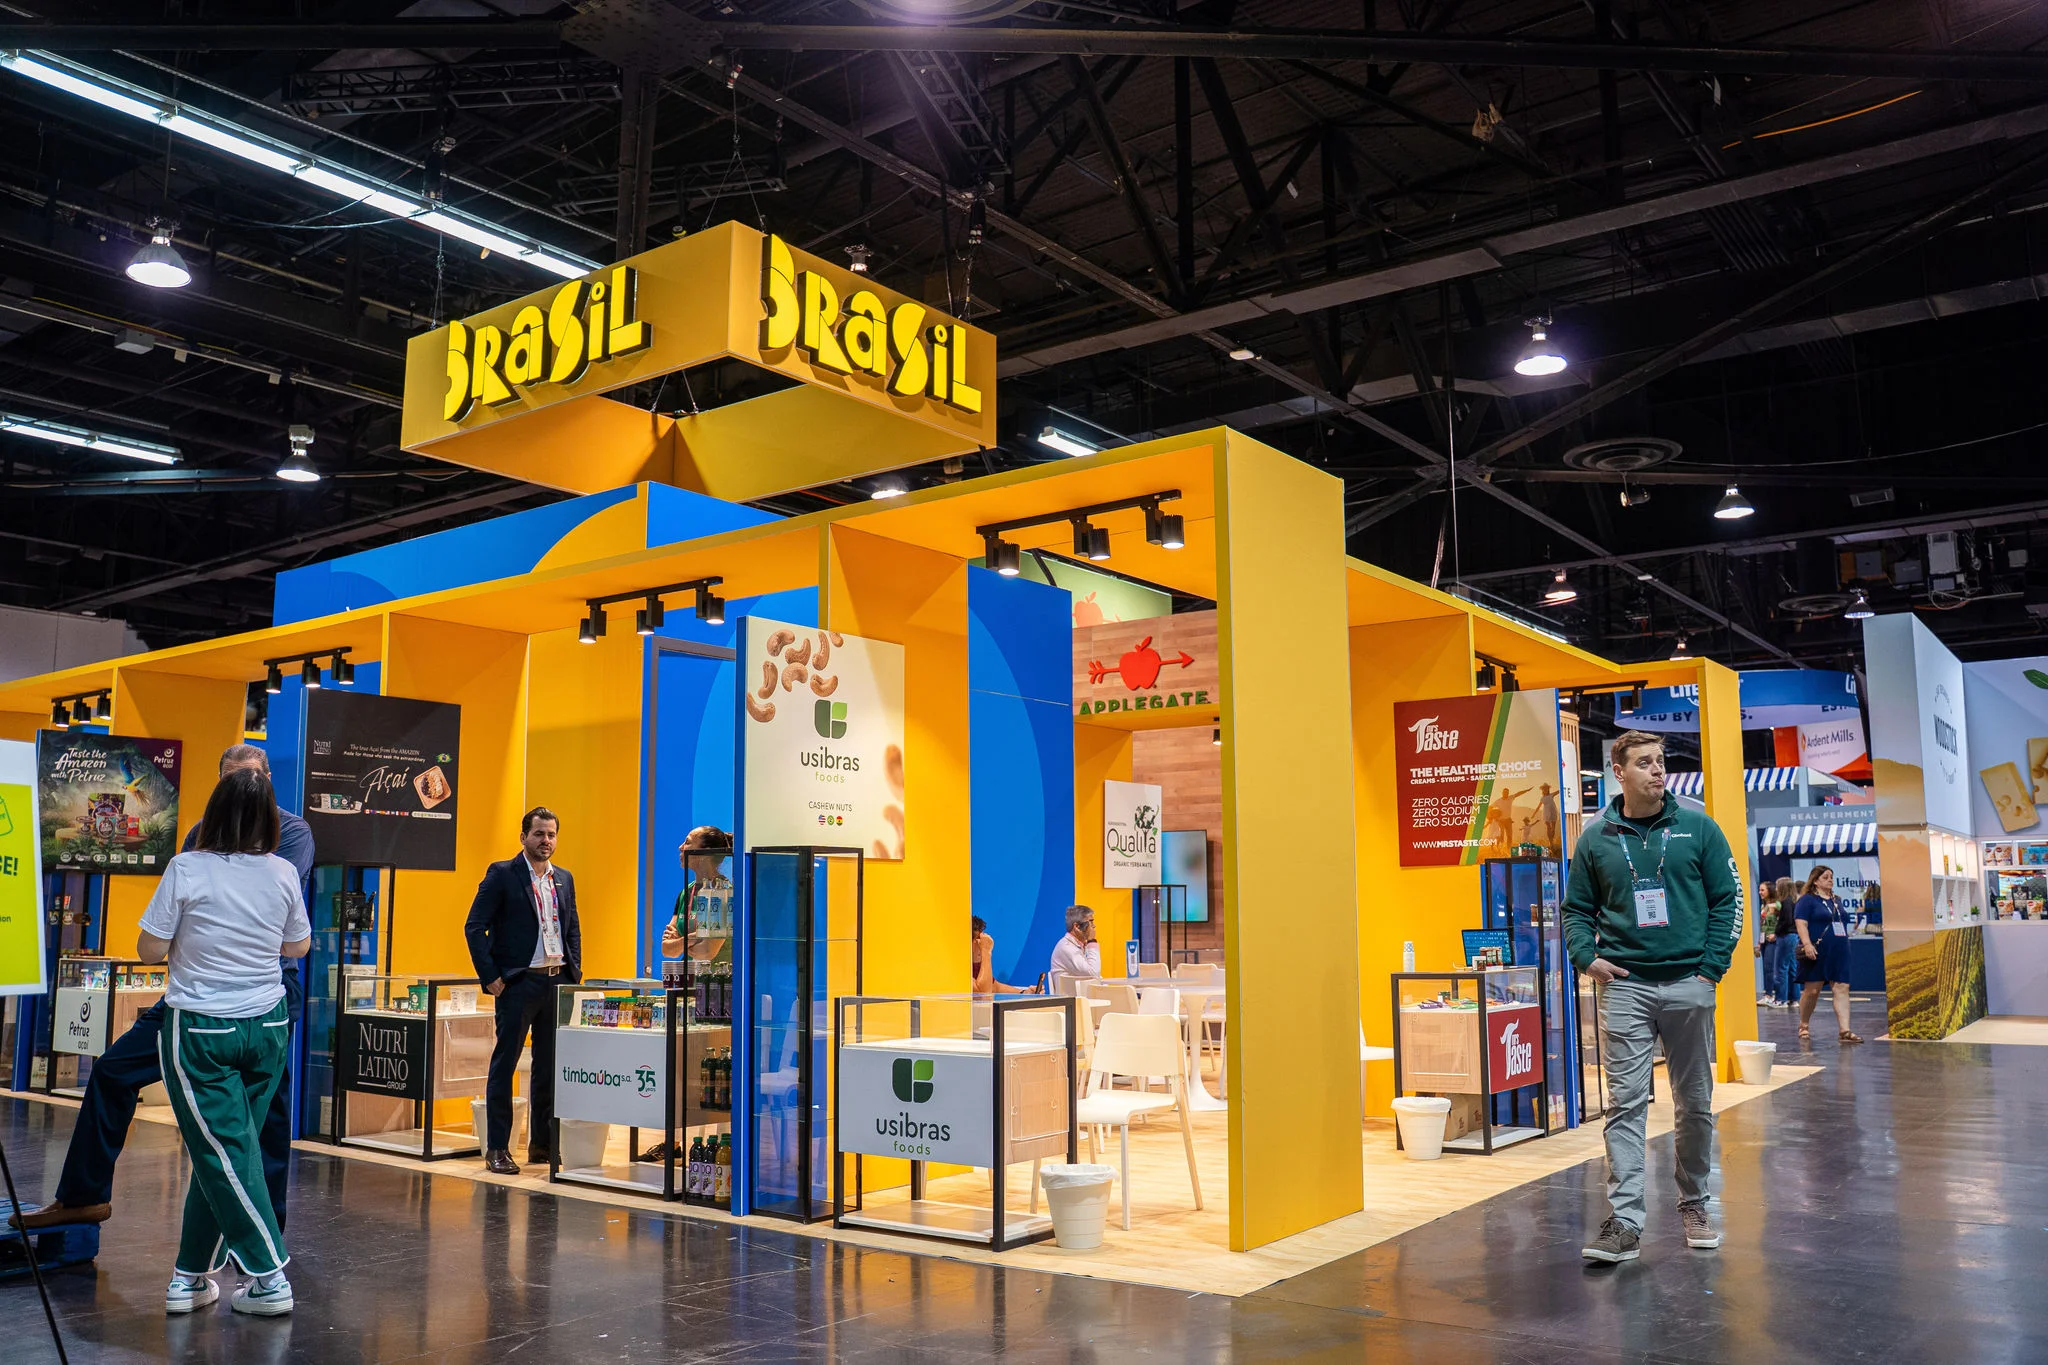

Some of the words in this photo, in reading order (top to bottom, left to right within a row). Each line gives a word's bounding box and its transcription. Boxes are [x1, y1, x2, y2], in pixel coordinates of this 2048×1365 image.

[1408, 715, 1459, 754] Taste
[1807, 734, 1830, 748] Ardent
[68, 747, 91, 759] Taste
[91, 749, 107, 759] the
[800, 746, 860, 772] usibras
[54, 752, 107, 771] Amazon
[1410, 767, 1433, 778] THE
[1434, 763, 1496, 777] HEALTHIER
[1498, 760, 1542, 772] CHOICE
[67, 768, 107, 783] Petruz
[815, 771, 846, 784] foods
[808, 801, 835, 811] CASHEW
[836, 803, 852, 812] NUTS
[1412, 797, 1439, 808] ZERO
[1440, 794, 1490, 806] CALORIES
[1412, 807, 1440, 818] ZERO
[1440, 806, 1480, 817] SODIUM
[1790, 812, 1819, 820] REAL
[1412, 817, 1440, 828] ZERO
[1440, 816, 1476, 826] SUGAR
[68, 1021, 90, 1038] Petruz
[1500, 1018, 1532, 1080] Taste
[358, 1054, 409, 1082] LATINO
[386, 1081, 407, 1091] GROUP
[562, 1066, 620, 1087] timbaúba
[635, 1070, 656, 1092] 35
[876, 1112, 951, 1142] usibras
[893, 1141, 931, 1156] foods
